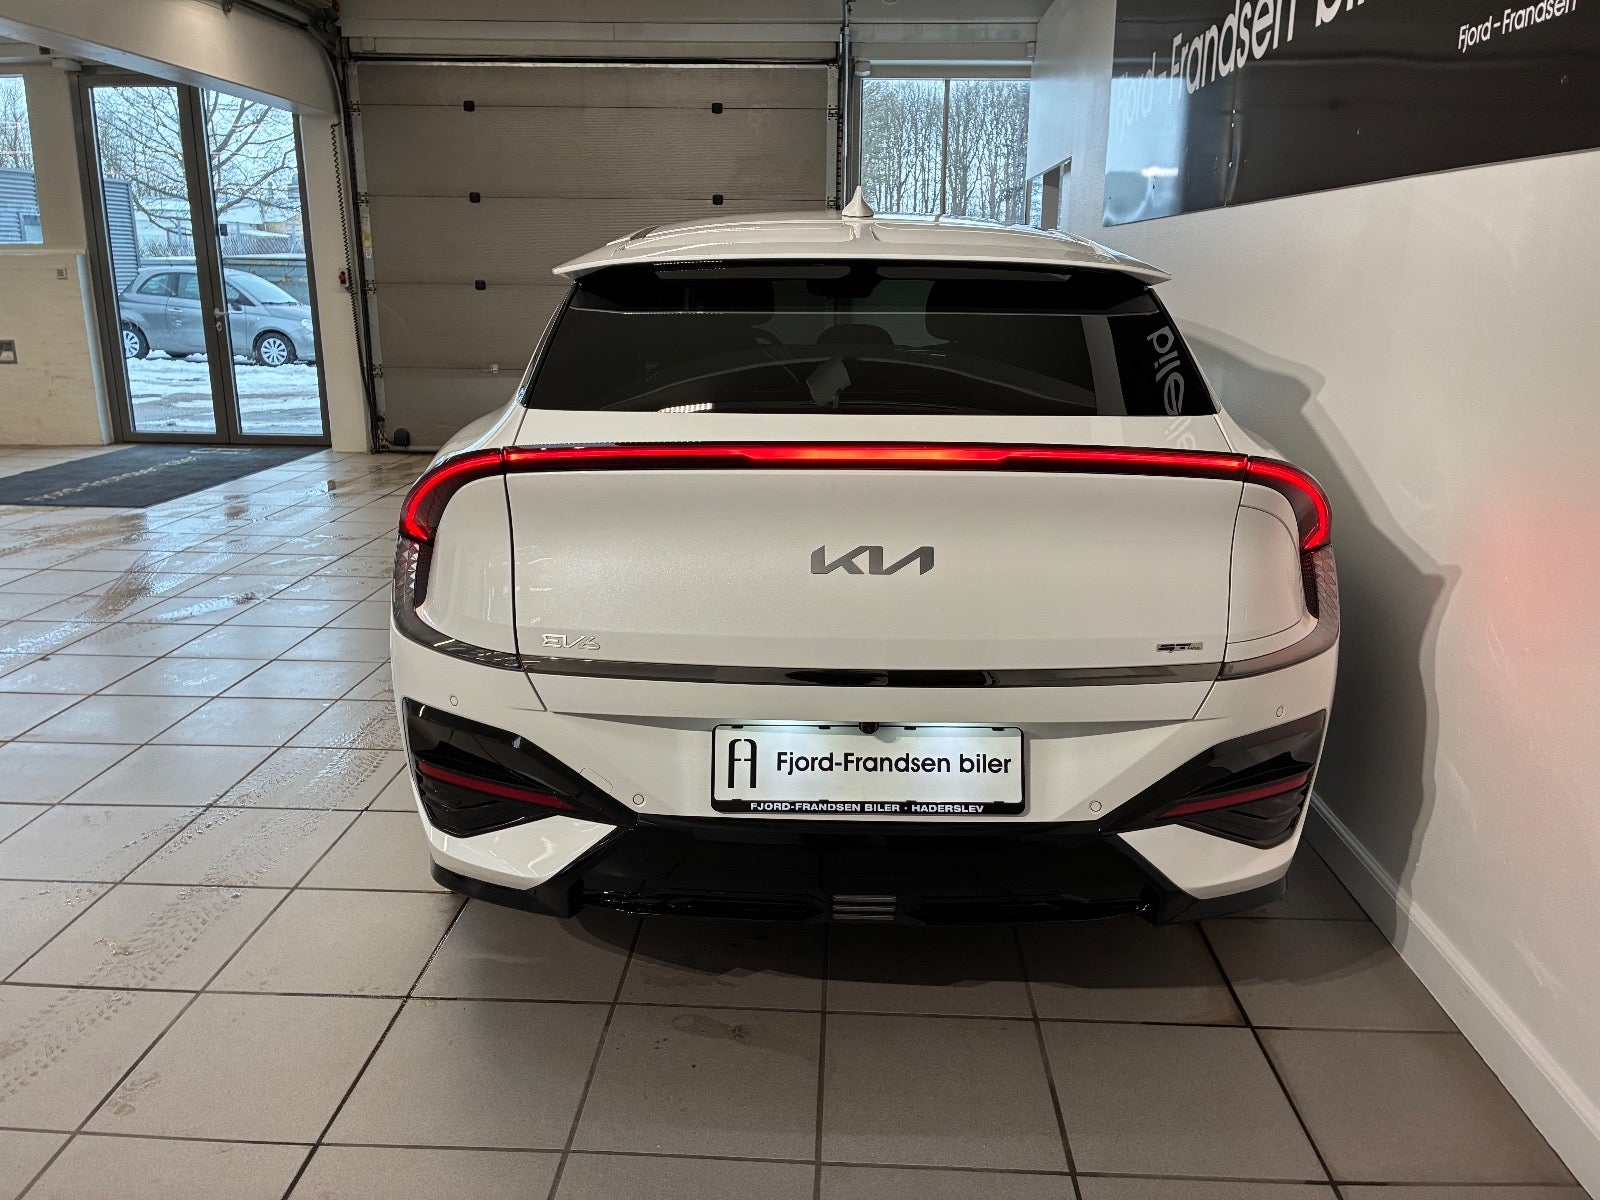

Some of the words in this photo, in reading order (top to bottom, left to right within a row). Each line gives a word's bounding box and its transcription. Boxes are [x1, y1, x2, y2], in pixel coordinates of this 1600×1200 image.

[1458, 0, 1577, 53] Fjord-Frandsen
[541, 633, 601, 651] EV6
[776, 751, 951, 776] Fjord-Frandsen
[959, 753, 1012, 774] biler
[750, 802, 861, 812] FJORD-FRANDSEN
[864, 802, 900, 812] BILER
[911, 804, 984, 813] HADERSLEV
